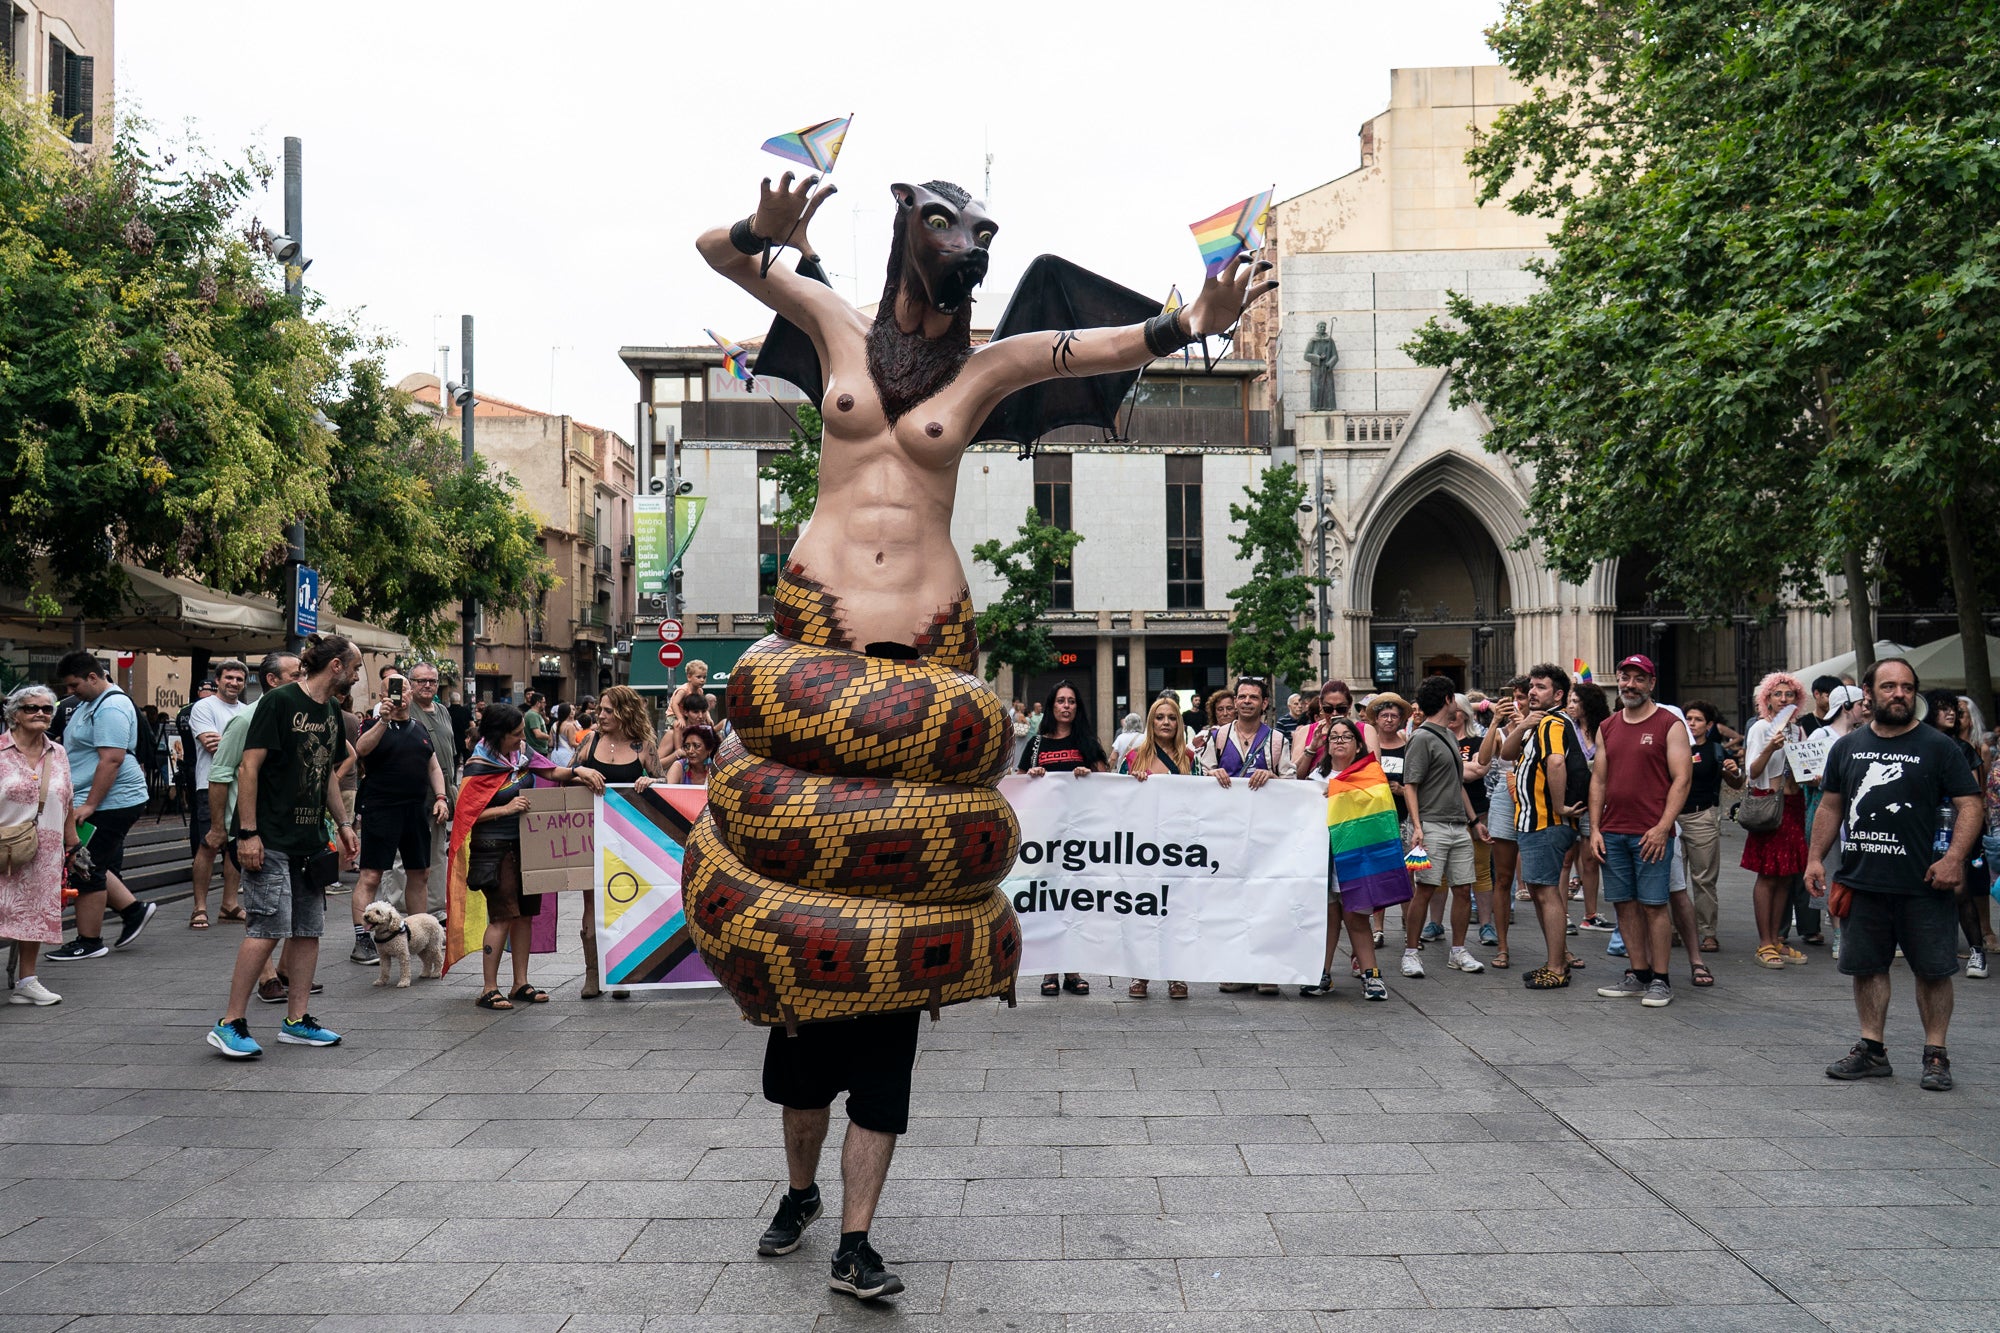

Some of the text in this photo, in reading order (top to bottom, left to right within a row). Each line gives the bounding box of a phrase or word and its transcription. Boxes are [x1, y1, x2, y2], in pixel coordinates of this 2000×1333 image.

[639, 560, 651, 568] del
[639, 569, 665, 579] patinet
[1852, 751, 1921, 764] VOLEM CANVIAR
[1849, 831, 1899, 843] SABADELL
[1019, 831, 1220, 875] orgullosa,
[1844, 842, 1858, 852] PER
[1012, 880, 1170, 917] diversa!
